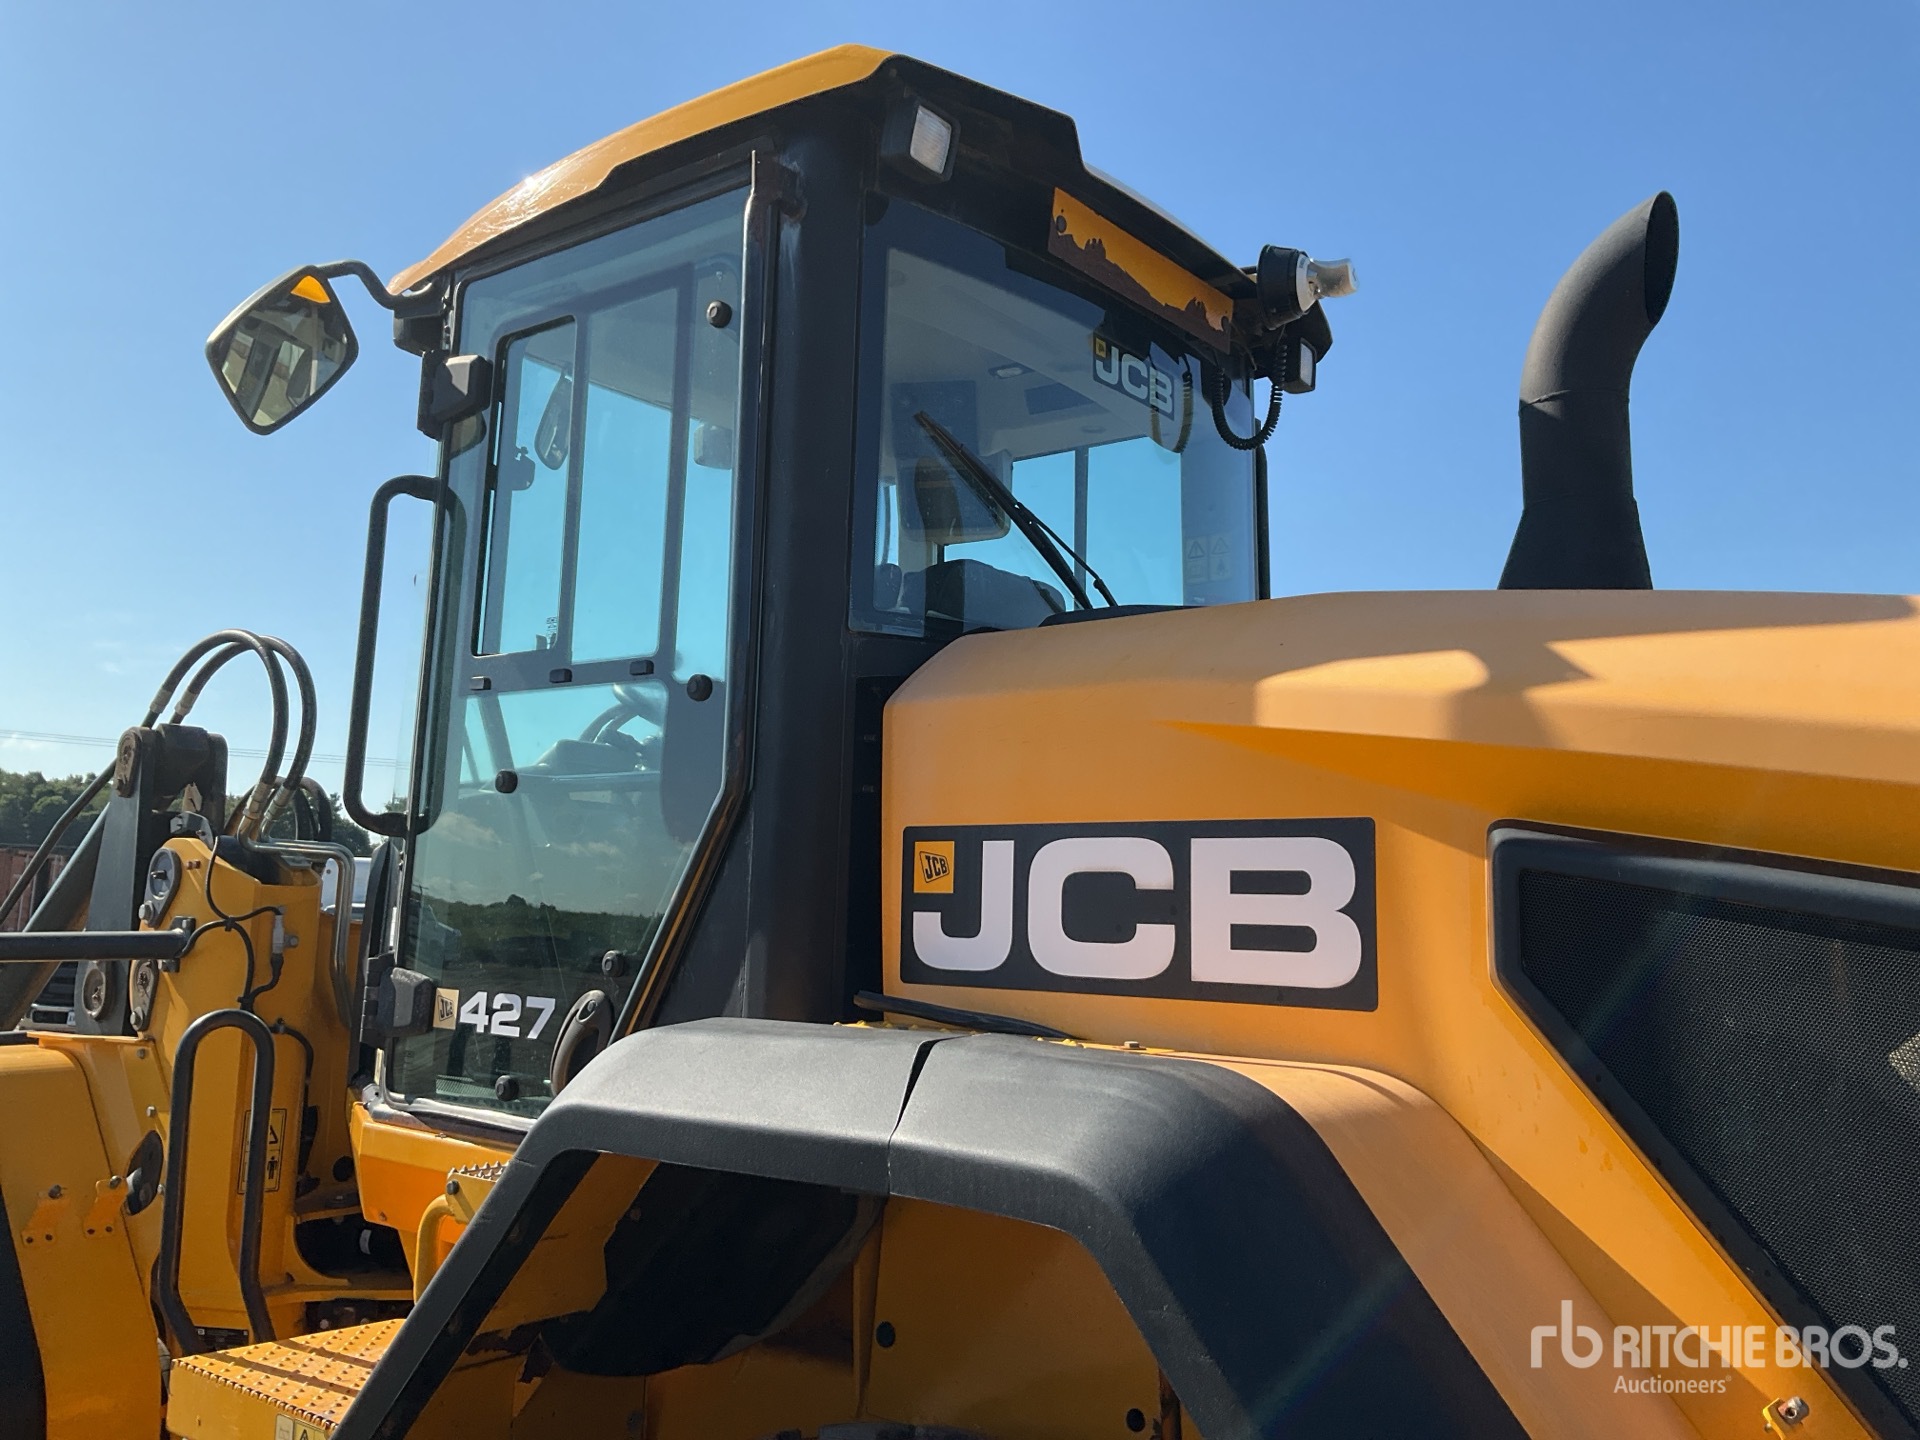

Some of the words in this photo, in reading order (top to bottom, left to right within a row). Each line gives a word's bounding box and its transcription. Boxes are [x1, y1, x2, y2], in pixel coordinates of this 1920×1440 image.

[1096, 346, 1172, 414] JCB
[924, 854, 948, 880] JCB
[912, 836, 1363, 989] JCB
[459, 991, 556, 1040] 427
